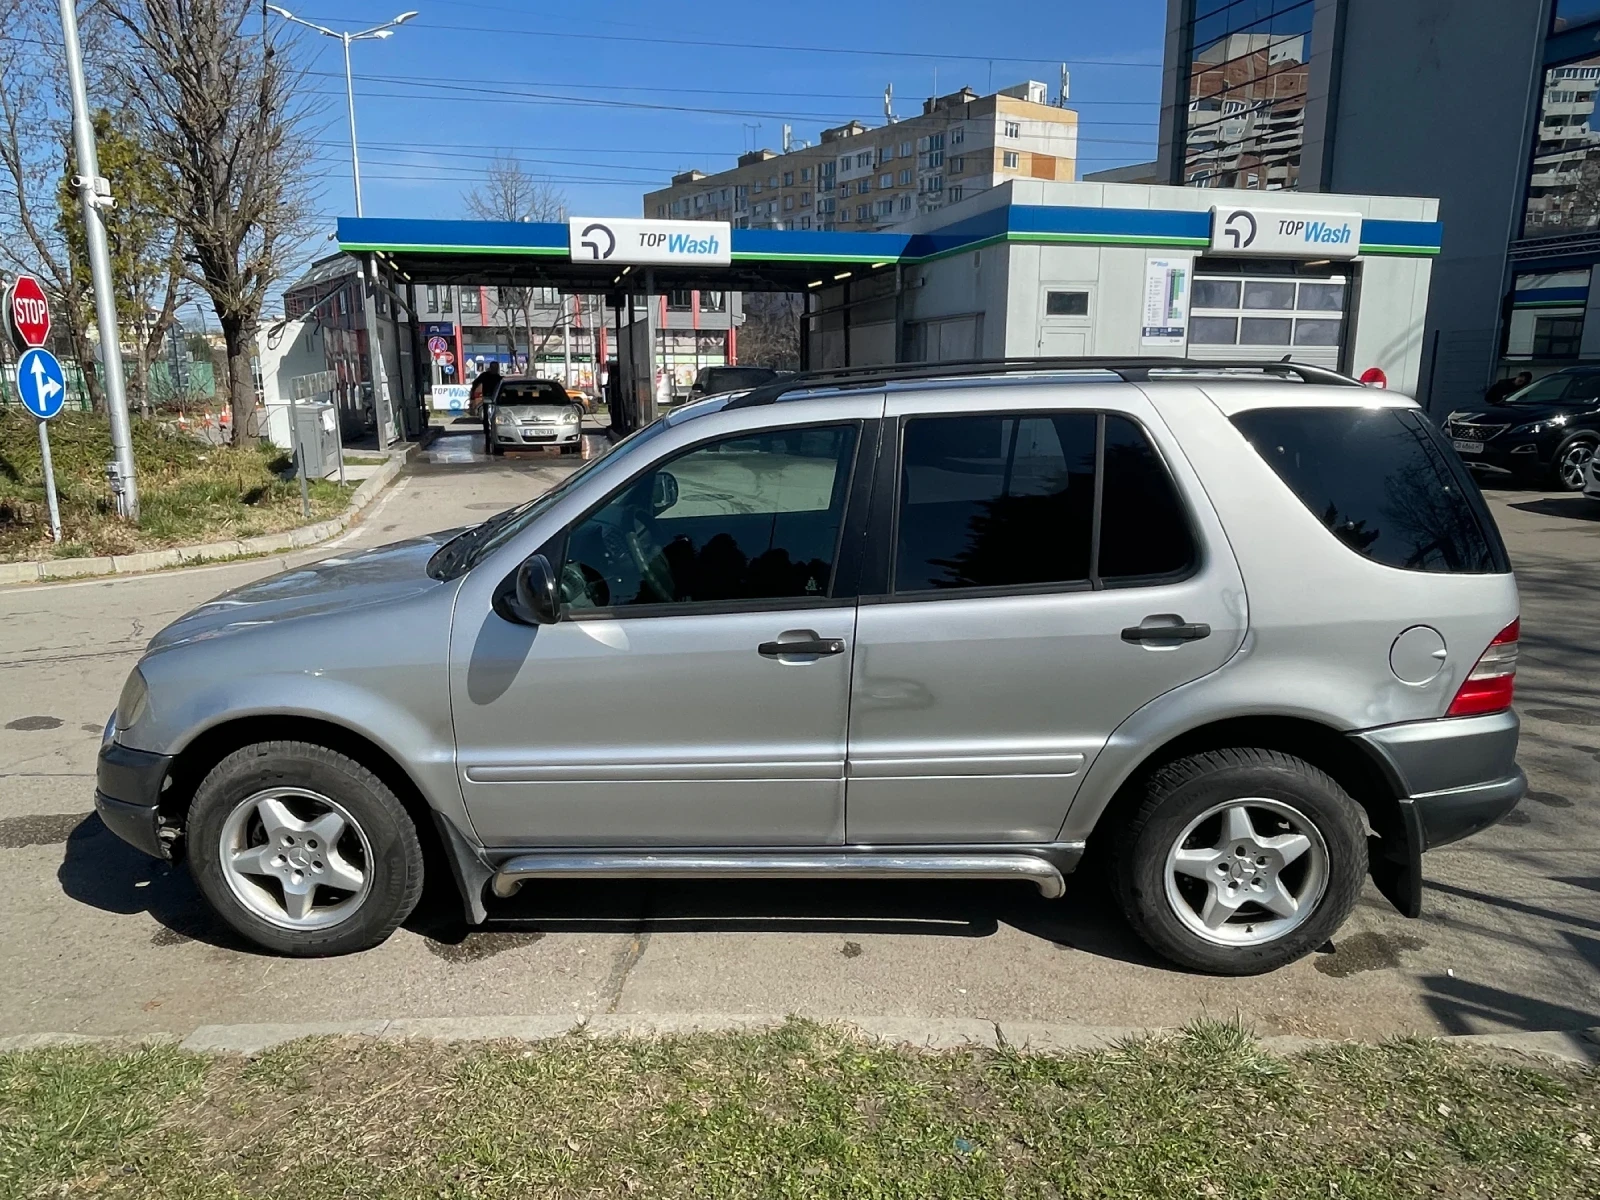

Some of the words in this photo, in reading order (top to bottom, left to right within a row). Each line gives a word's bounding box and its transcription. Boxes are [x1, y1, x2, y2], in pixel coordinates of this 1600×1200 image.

[639, 232, 667, 247] TOP
[668, 233, 720, 255] Wash
[1278, 220, 1304, 236] TOP
[1304, 221, 1352, 244] Wash
[15, 298, 46, 325] STOP
[434, 387, 449, 395] TOP
